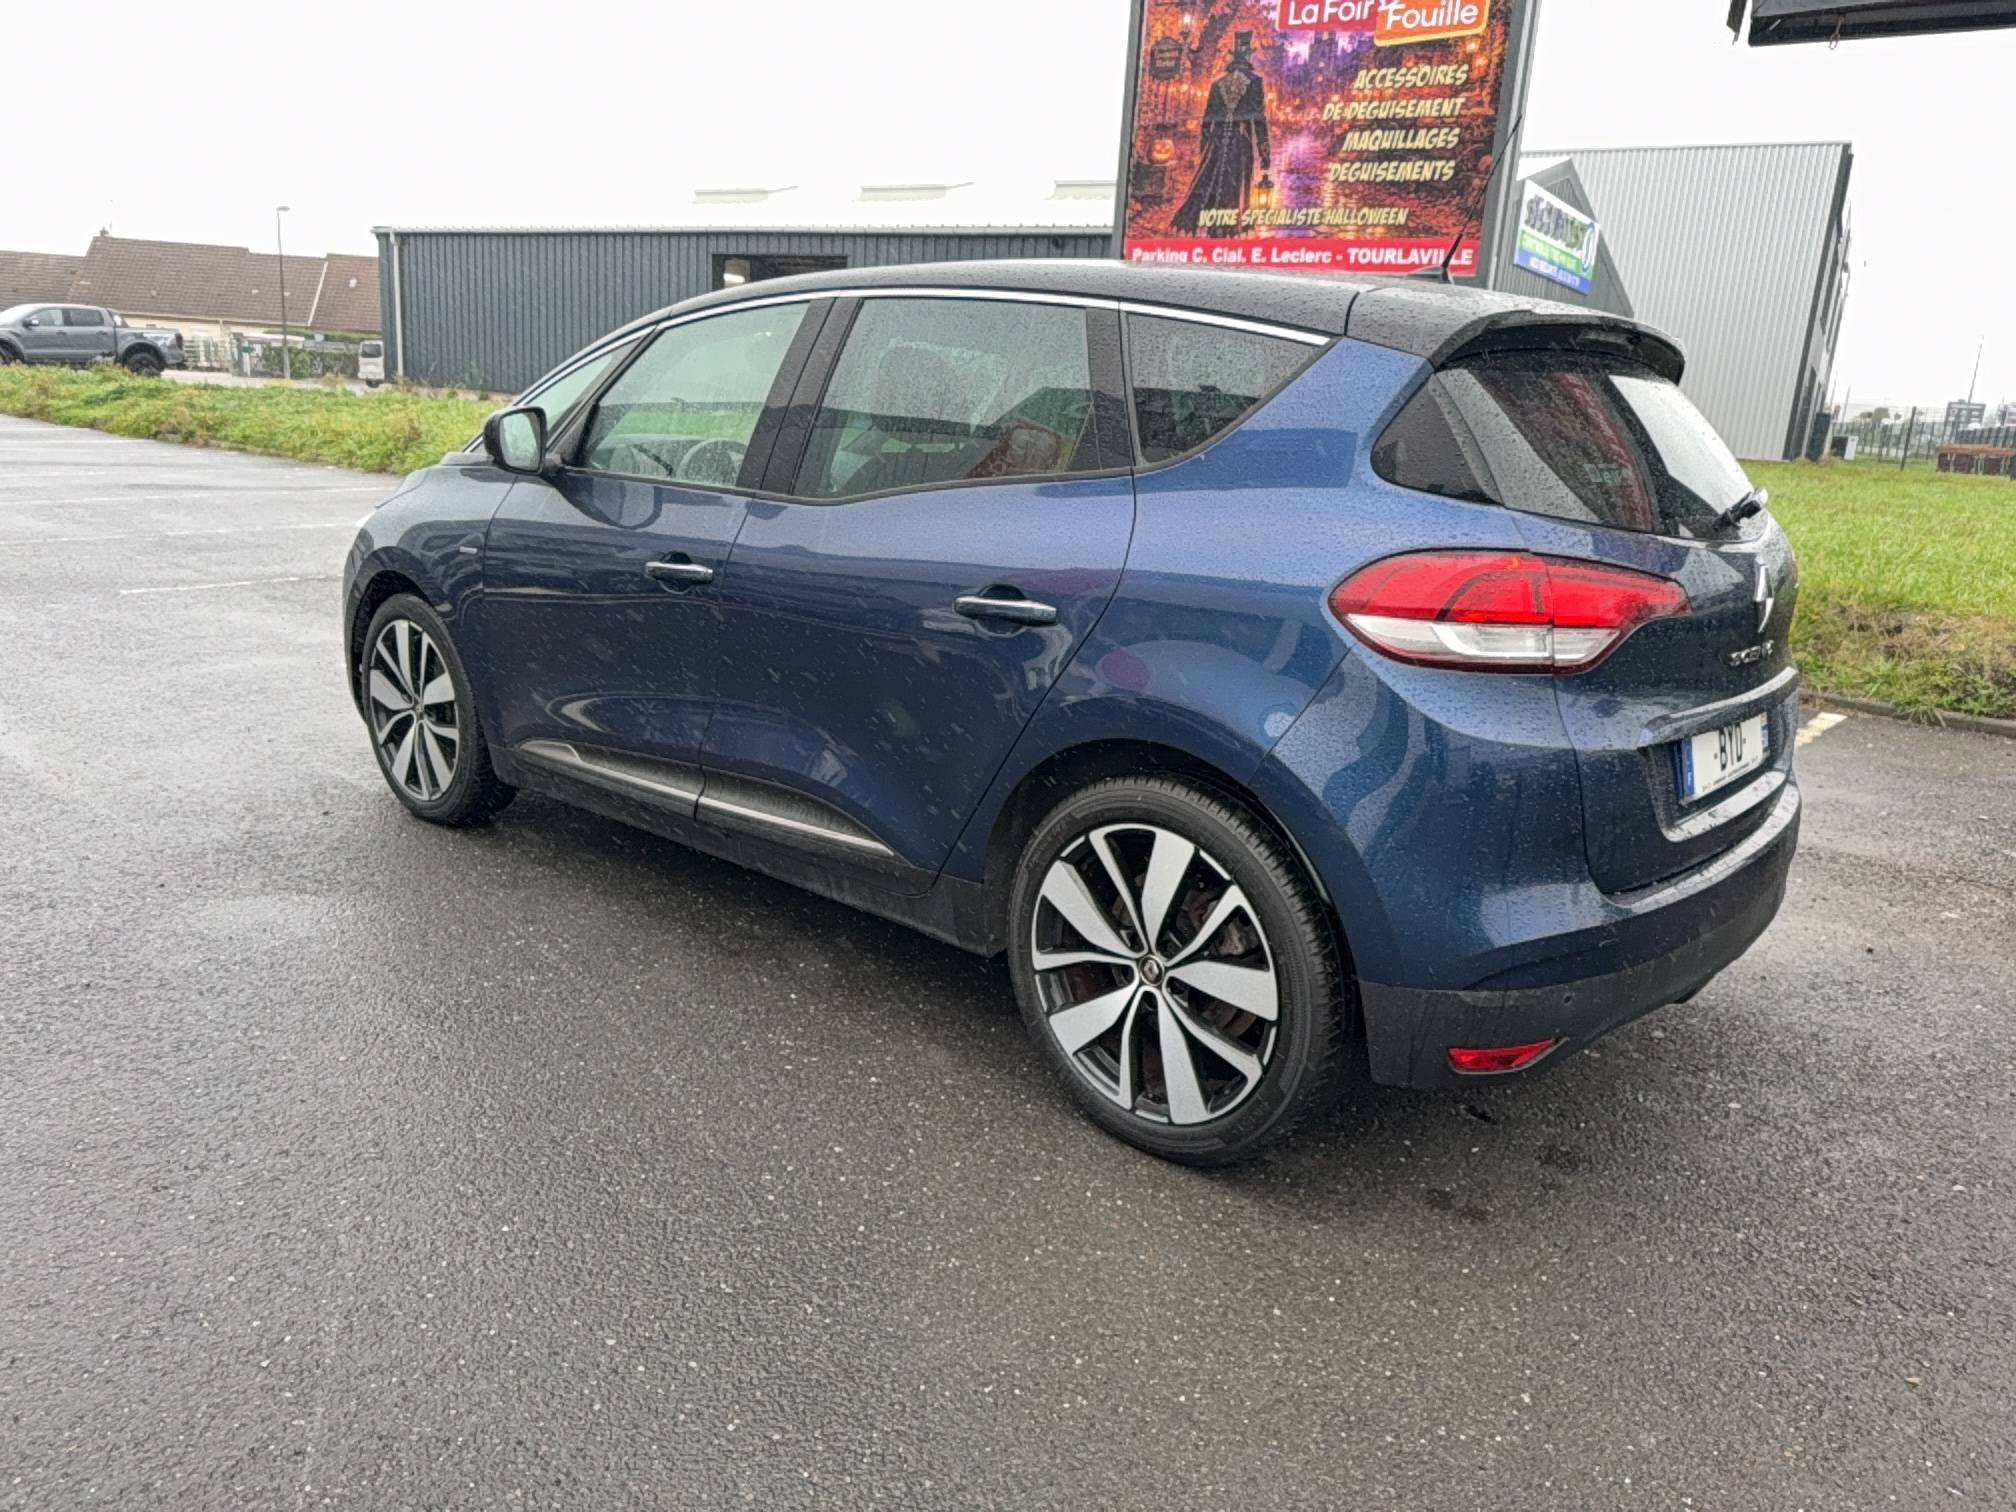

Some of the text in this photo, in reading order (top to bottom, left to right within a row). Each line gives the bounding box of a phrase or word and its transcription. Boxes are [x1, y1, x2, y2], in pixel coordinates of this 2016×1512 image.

[1288, 0, 1319, 25] La
[1384, 0, 1479, 30] Fouille
[1354, 63, 1469, 90] ACCESSOIRES
[1322, 97, 1467, 121] DE DEGUISEMENT
[1342, 127, 1461, 152] MAQUILLAGES
[1328, 159, 1456, 182] DEGUISEMENTS
[1199, 206, 1410, 227] VOTRE SPECIALISTE HALLOWEEN
[1251, 247, 1266, 263] E.
[1271, 246, 1332, 264] Leclerc
[1347, 247, 1474, 265] TOURLAVILLE
